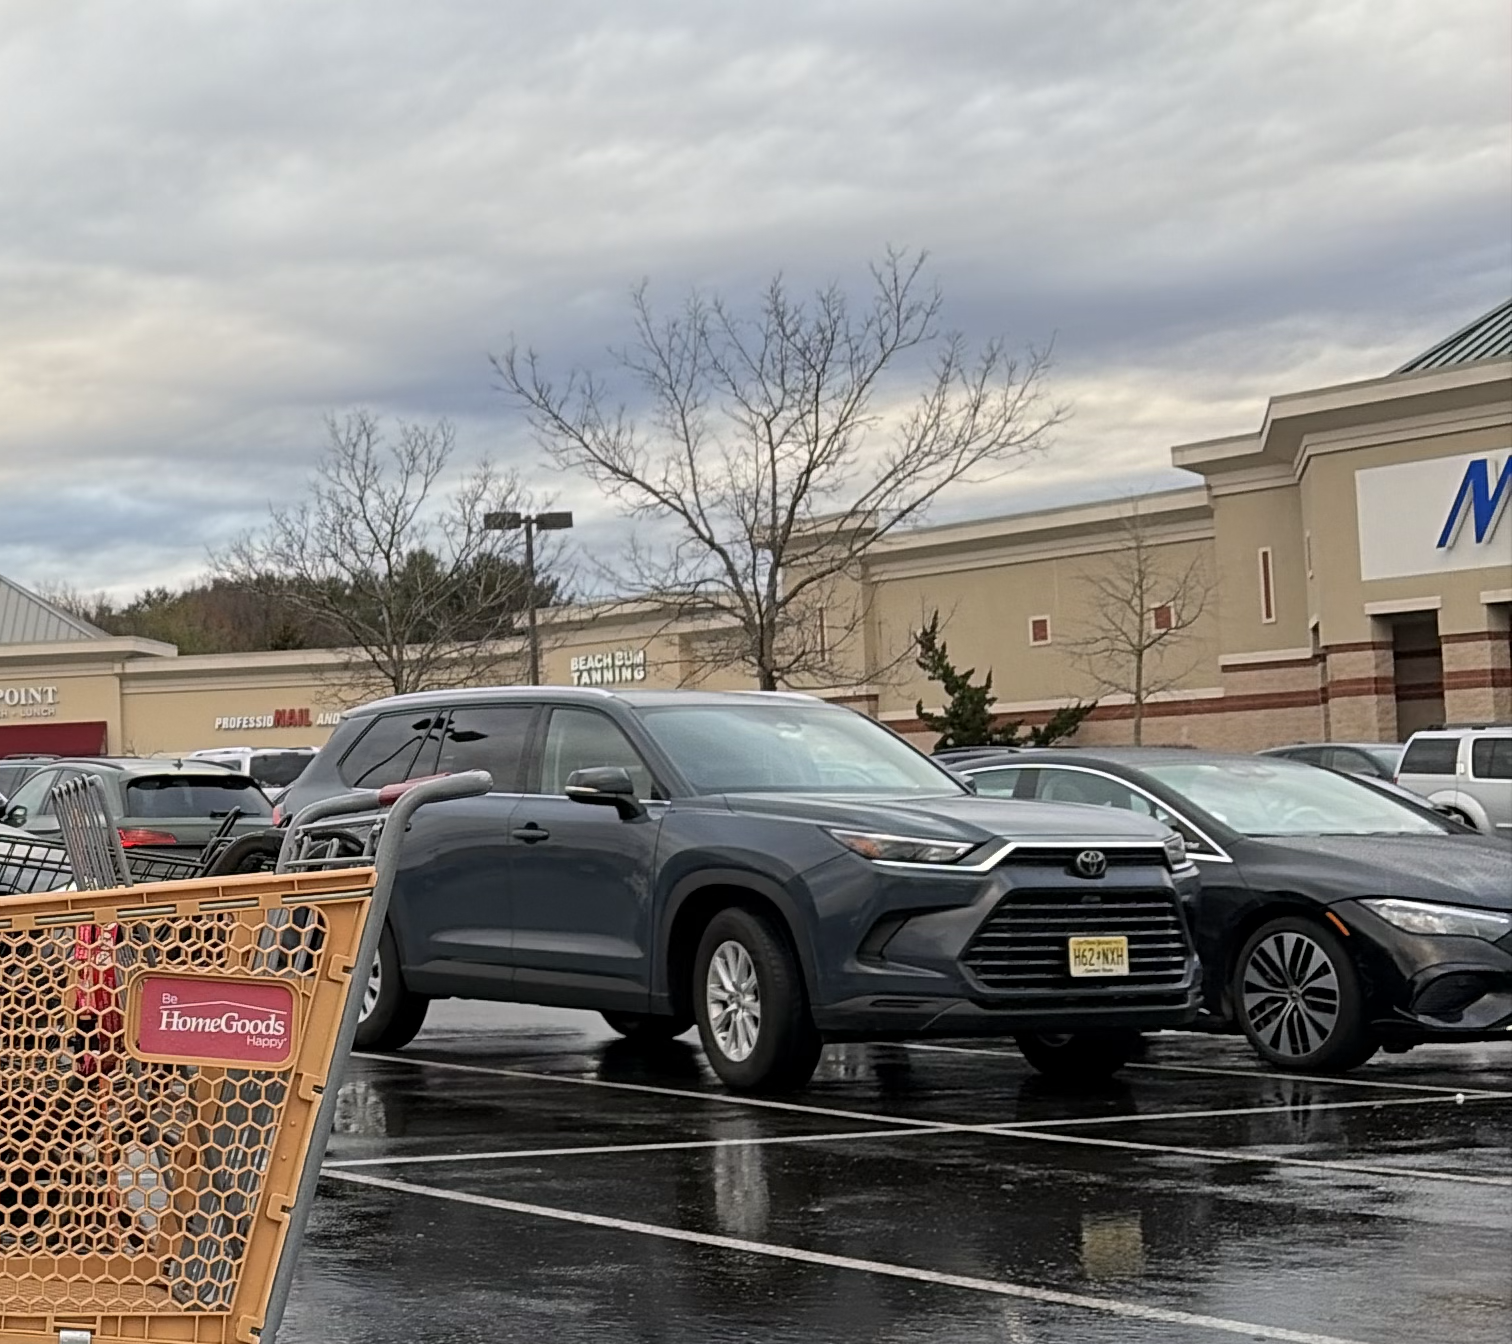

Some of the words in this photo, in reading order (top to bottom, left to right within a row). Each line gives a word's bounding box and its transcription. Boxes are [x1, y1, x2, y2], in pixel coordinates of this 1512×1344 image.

[570, 652, 613, 671] BEACH
[614, 649, 646, 666] BUM
[570, 666, 646, 686] TANNING
[19, 707, 56, 718] LUNCH
[316, 712, 341, 726] AND
[161, 992, 179, 1004] Be
[158, 1009, 285, 1036] HomeGoods
[246, 1035, 284, 1049] Happy
